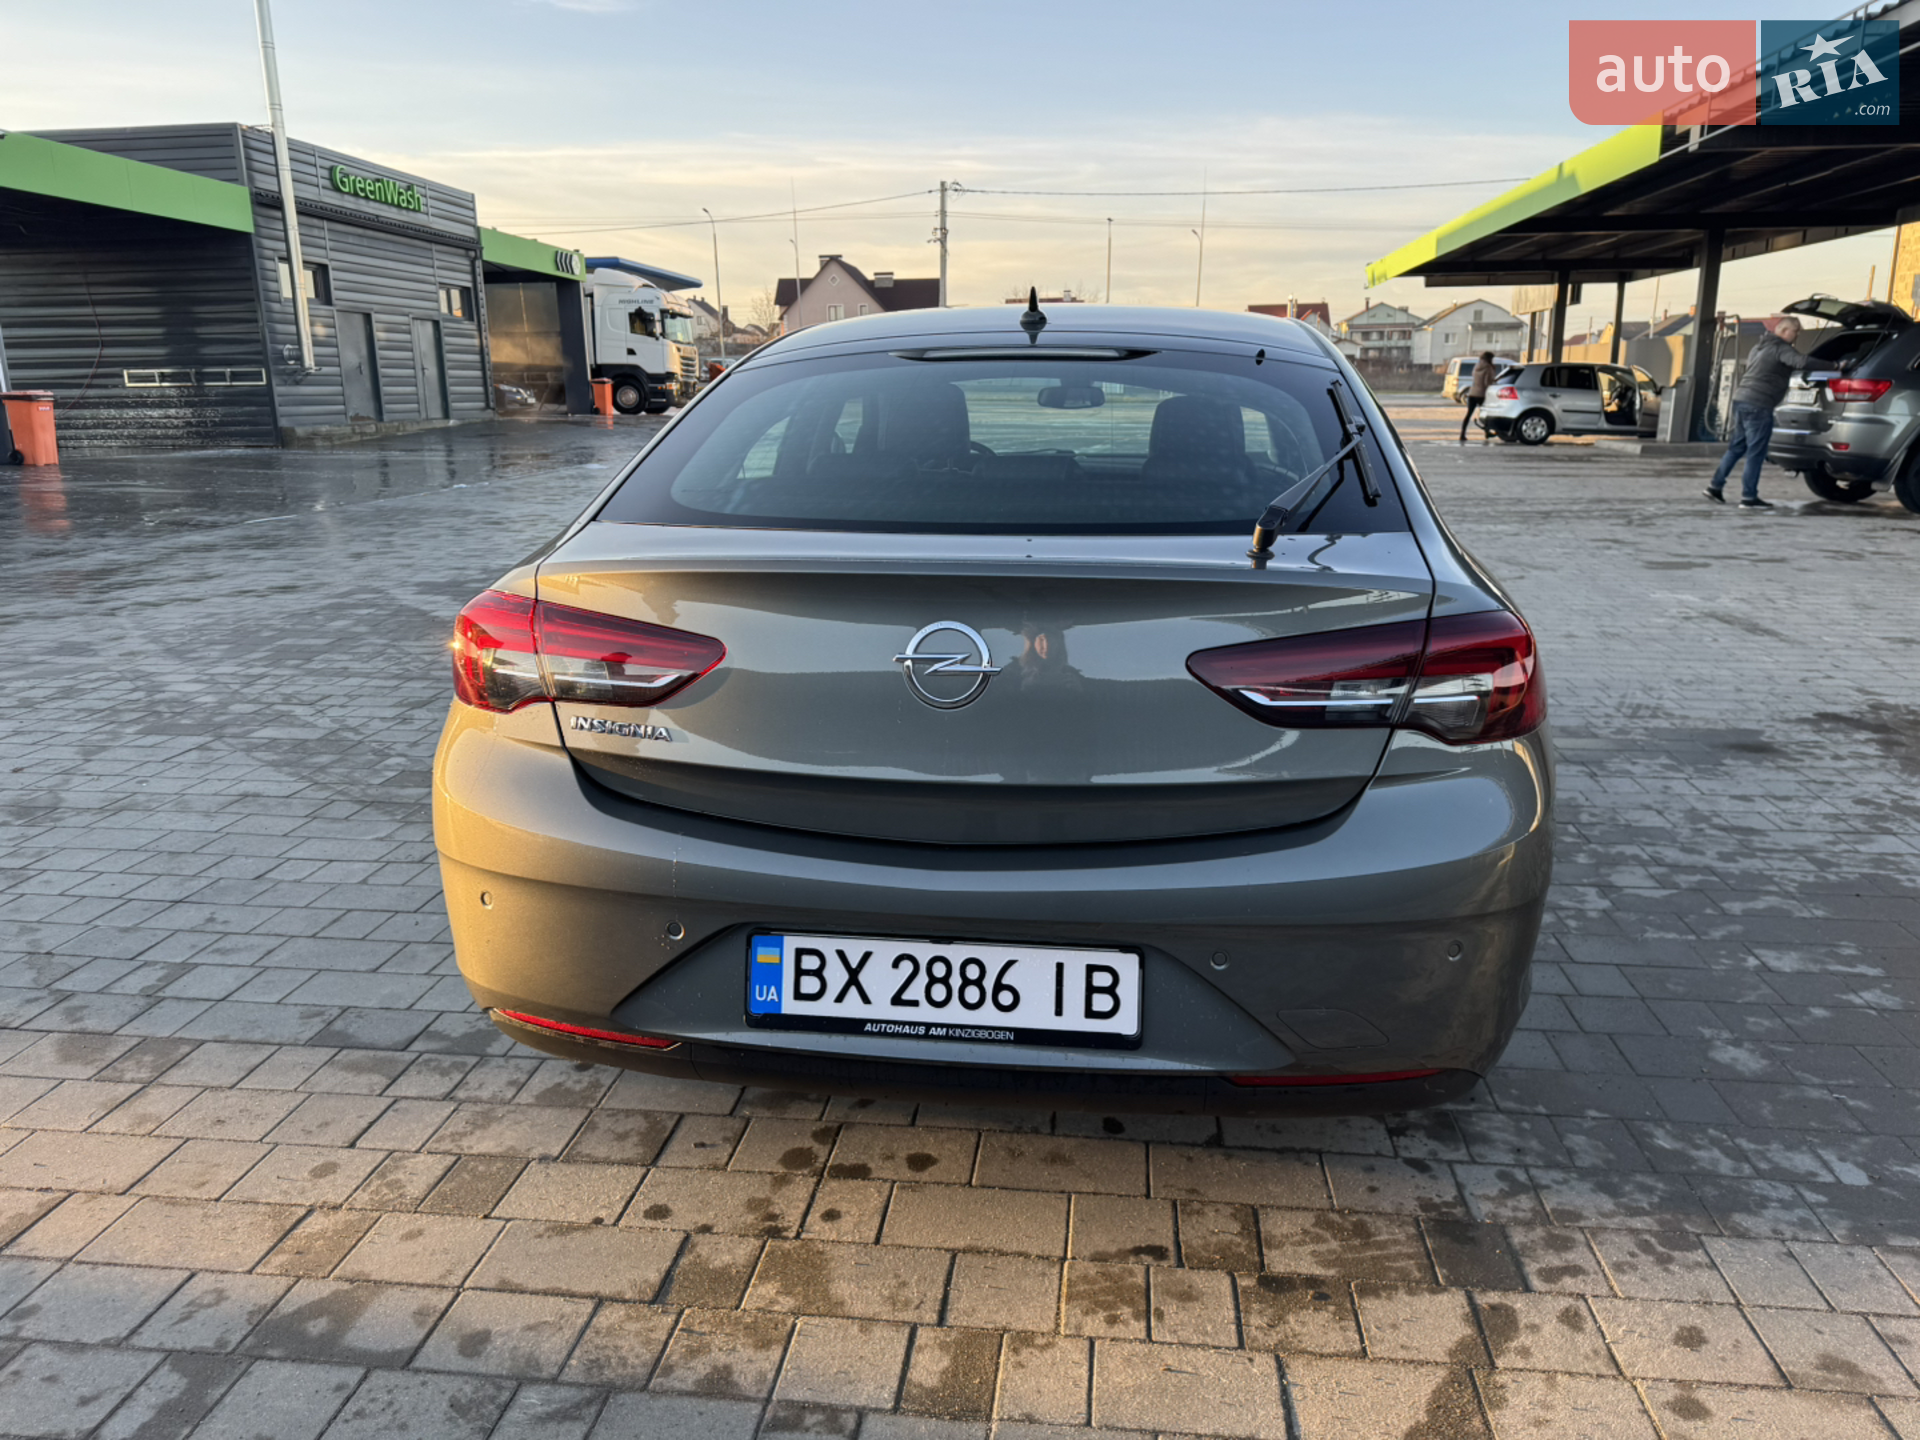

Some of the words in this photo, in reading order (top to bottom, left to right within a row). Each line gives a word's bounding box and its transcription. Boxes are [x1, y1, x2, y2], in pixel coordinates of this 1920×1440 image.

[330, 164, 424, 213] GreenWash
[570, 715, 672, 742] INSIGNIA
[755, 984, 779, 1002] UA
[793, 947, 874, 1005] BX
[890, 953, 1021, 1013] 2886
[1054, 961, 1121, 1020] IB
[863, 1022, 926, 1036] AUTOHAUS
[928, 1026, 947, 1037] AM
[948, 1027, 1015, 1041] KINZIGBOGEN
